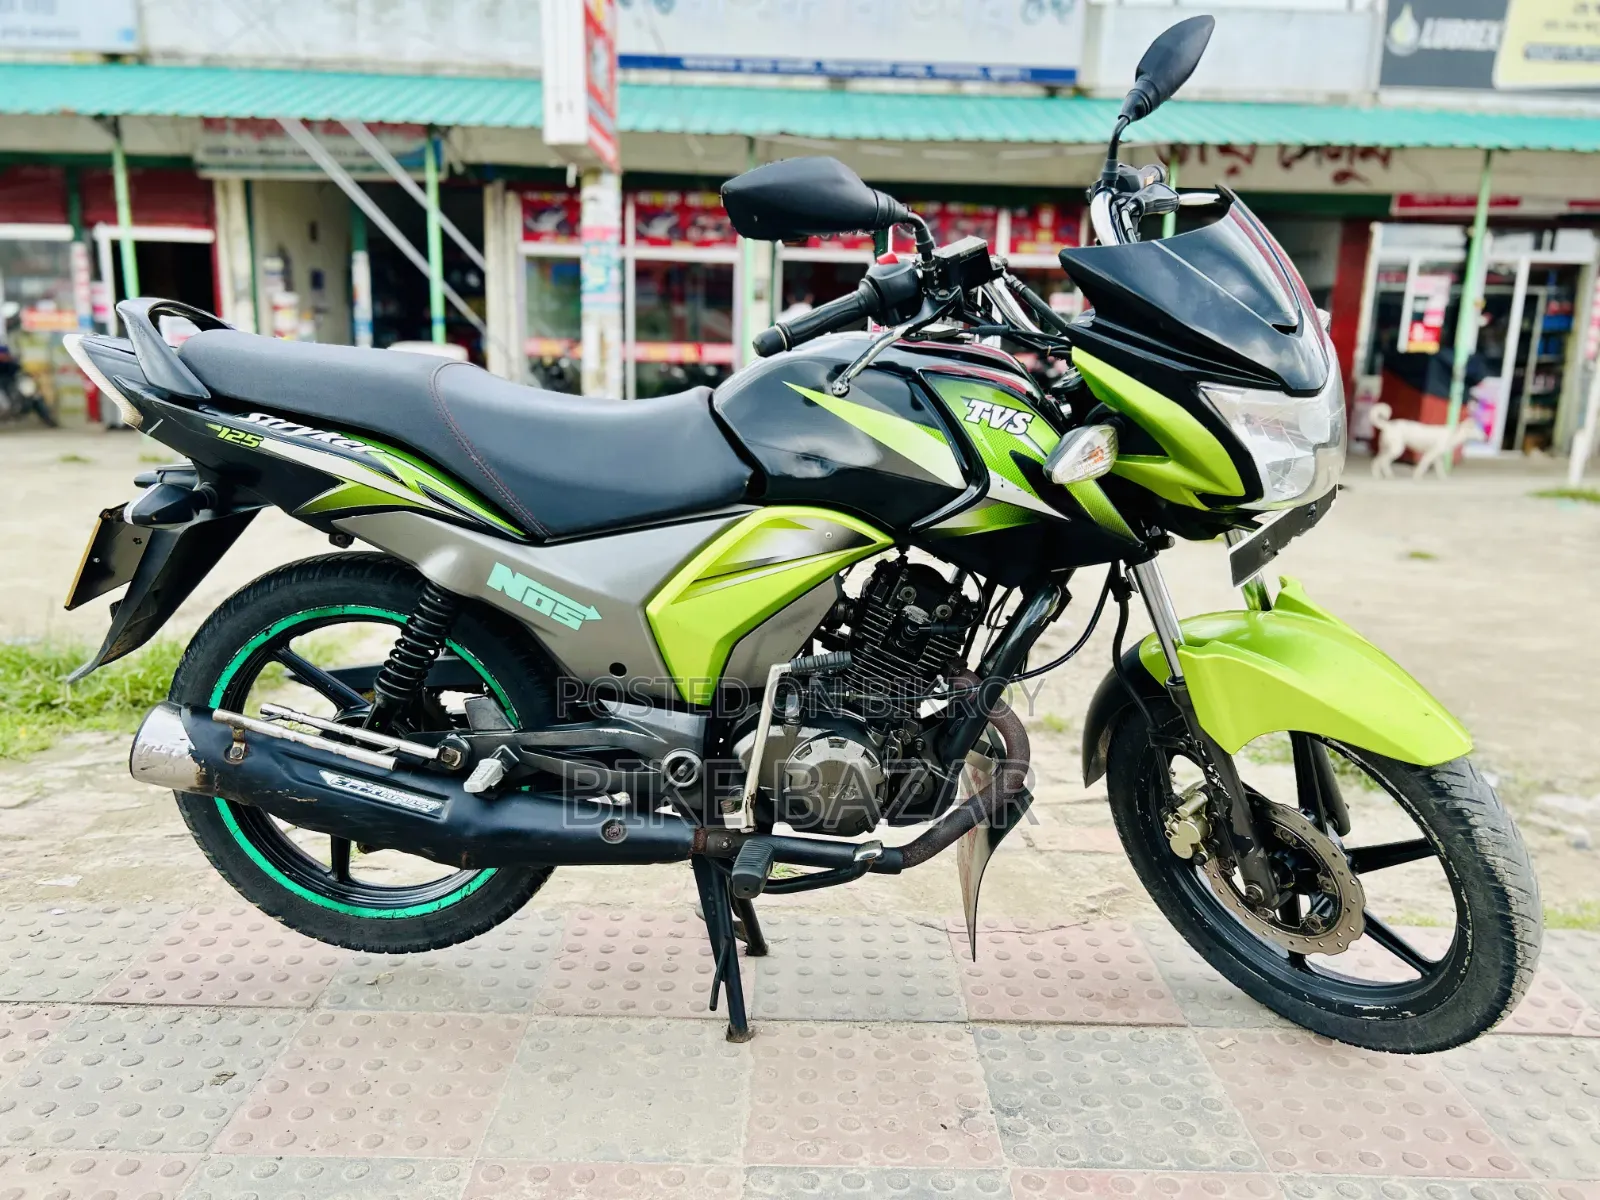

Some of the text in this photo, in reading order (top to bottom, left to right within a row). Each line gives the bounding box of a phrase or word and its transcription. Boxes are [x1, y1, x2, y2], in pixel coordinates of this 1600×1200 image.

[238, 412, 385, 453] Stryker
[964, 398, 1035, 436] TVS
[216, 424, 265, 449] 125
